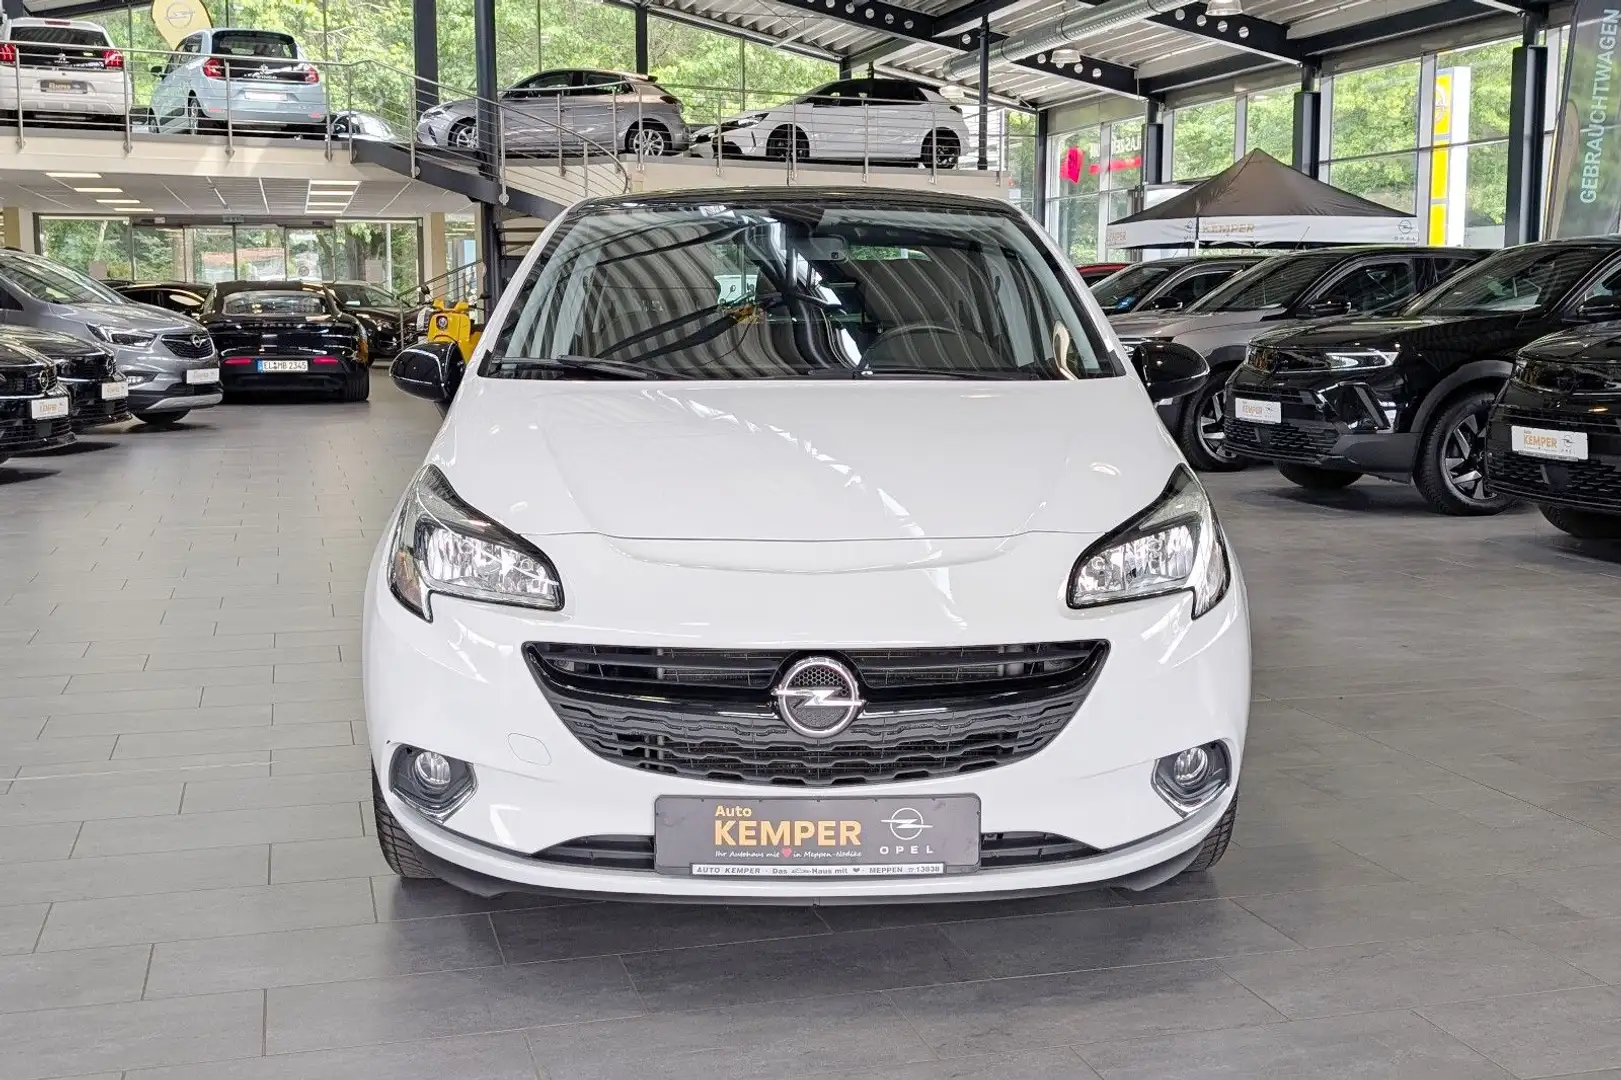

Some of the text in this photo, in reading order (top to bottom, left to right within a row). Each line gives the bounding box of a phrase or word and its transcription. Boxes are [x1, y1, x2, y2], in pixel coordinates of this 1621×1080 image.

[1579, 8, 1620, 204] GEBRAUCHTWAGEN
[1523, 434, 1558, 448] KEMPER
[714, 805, 752, 817] Auto
[714, 820, 862, 846] KEMPER
[715, 850, 727, 858] Ihr
[729, 850, 764, 858] Autohaus
[766, 850, 780, 858] mit
[793, 850, 802, 858] in
[879, 845, 934, 855] OPEL
[696, 866, 721, 874] AUTO
[834, 867, 848, 875] mit
